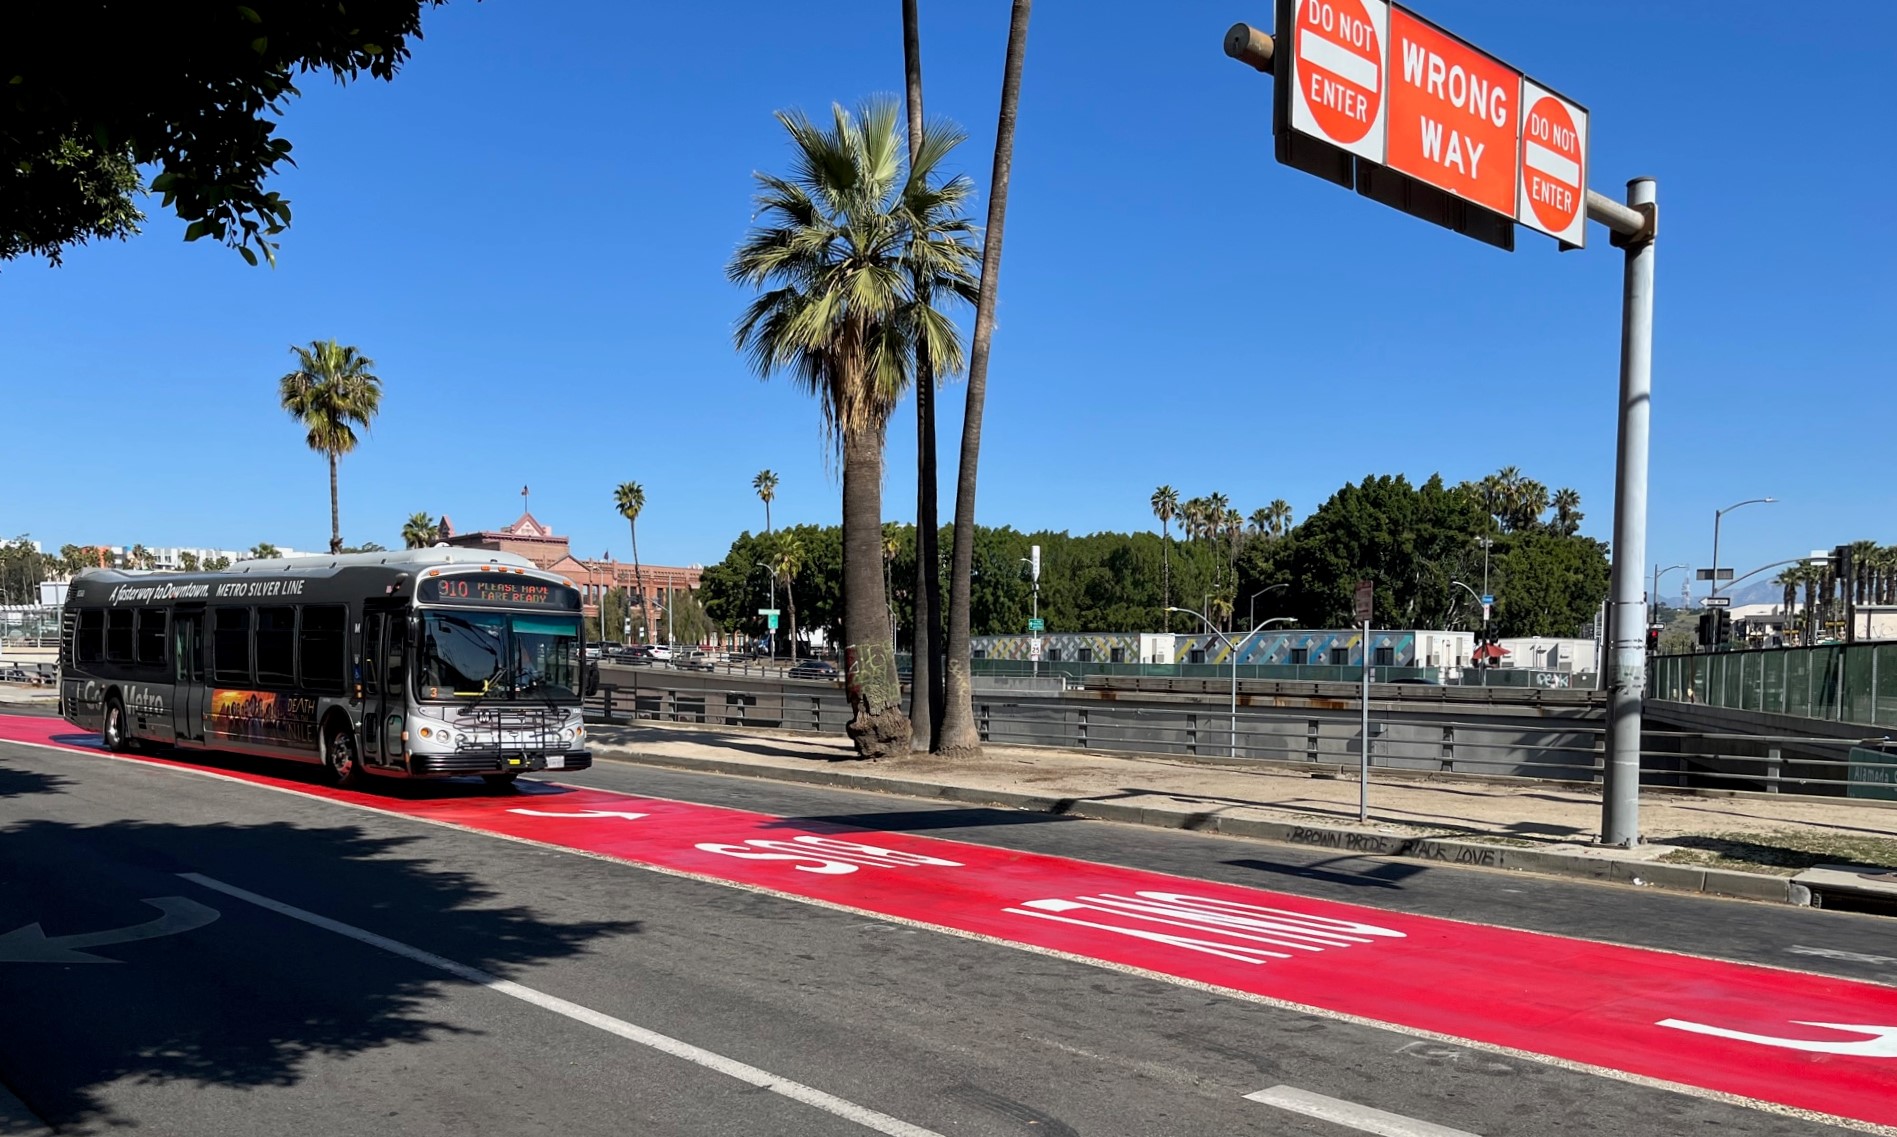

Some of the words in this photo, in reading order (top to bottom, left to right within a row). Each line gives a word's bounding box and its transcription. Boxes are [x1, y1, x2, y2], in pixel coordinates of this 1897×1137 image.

[1309, 0, 1333, 32] DO
[1340, 12, 1373, 51] NOT
[1311, 73, 1368, 123] ENTER
[1402, 37, 1507, 128] WRONG
[1420, 115, 1485, 180] WAY
[1531, 112, 1549, 141] DO
[1552, 123, 1576, 154] NOT
[1532, 176, 1571, 213] ENTER
[109, 586, 119, 601] A
[113, 584, 138, 606] faster
[137, 588, 155, 604] way
[216, 583, 248, 597] METRO
[248, 581, 281, 596] SILVER
[281, 580, 305, 595] LINE
[438, 580, 468, 597] 910
[477, 582, 518, 592] PLEASE
[123, 684, 163, 717] Metro
[287, 697, 315, 714] DEATH
[430, 687, 438, 698] 3
[1853, 766, 1889, 785] Alameda
[694, 836, 965, 874] BUS
[1291, 826, 1342, 848] BROWN
[1346, 833, 1388, 853] PRIDE
[1455, 846, 1495, 864] LOVE
[1001, 891, 1408, 965] ONLY
